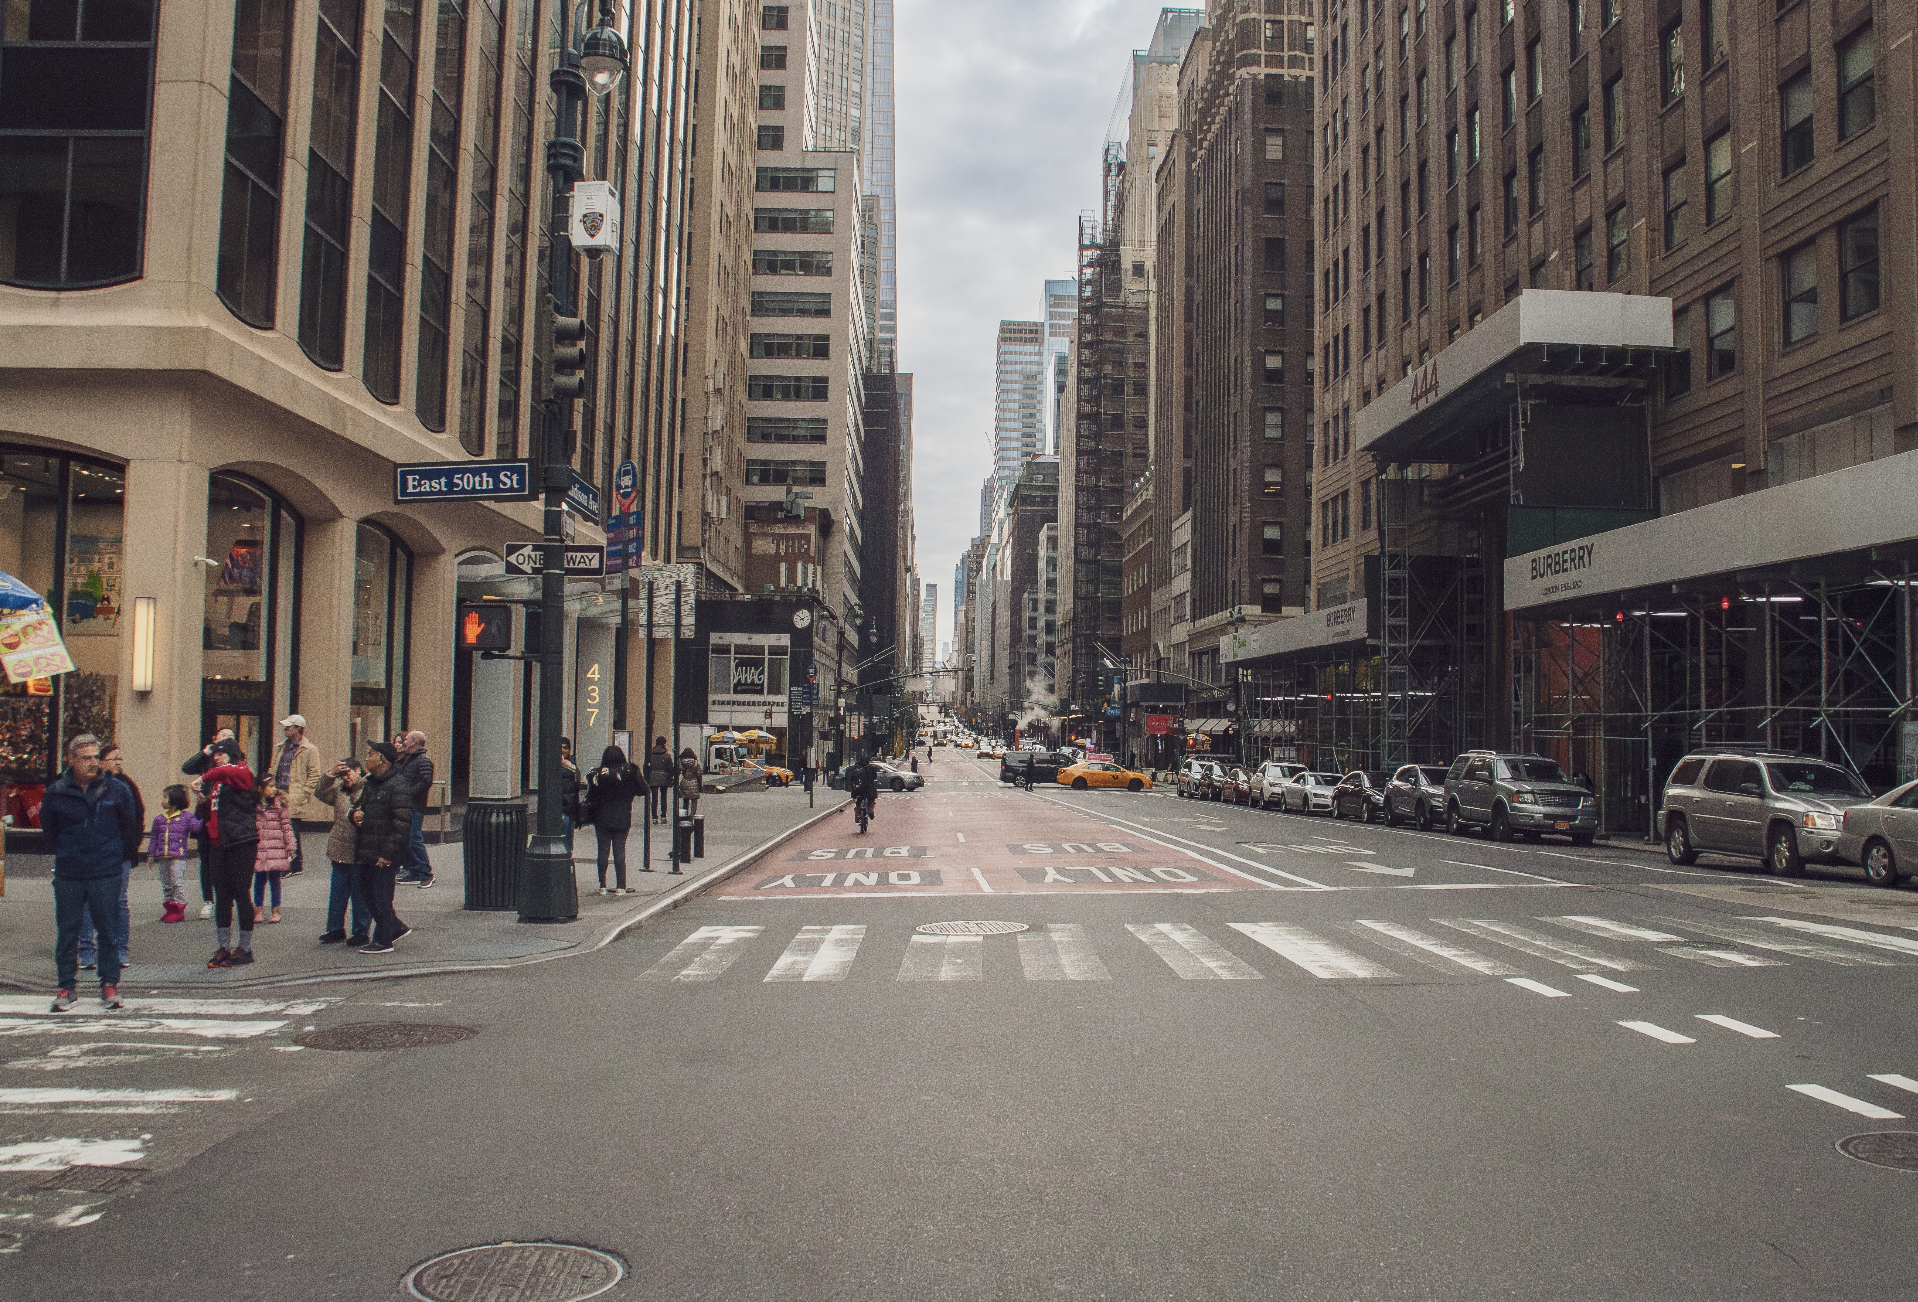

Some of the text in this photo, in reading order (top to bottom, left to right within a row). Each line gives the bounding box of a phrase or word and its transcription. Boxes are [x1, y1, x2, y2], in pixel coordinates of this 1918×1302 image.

[1411, 359, 1439, 410] 444
[406, 471, 520, 493] East 50th St
[515, 553, 544, 567] ONE
[566, 554, 596, 567] WAY
[1531, 543, 1594, 581] BURBERRY
[586, 663, 600, 727] 437
[808, 846, 911, 860] BUS
[1022, 842, 1133, 854] BUS
[760, 870, 921, 889] ONLY
[1044, 866, 1199, 883] ONLY
